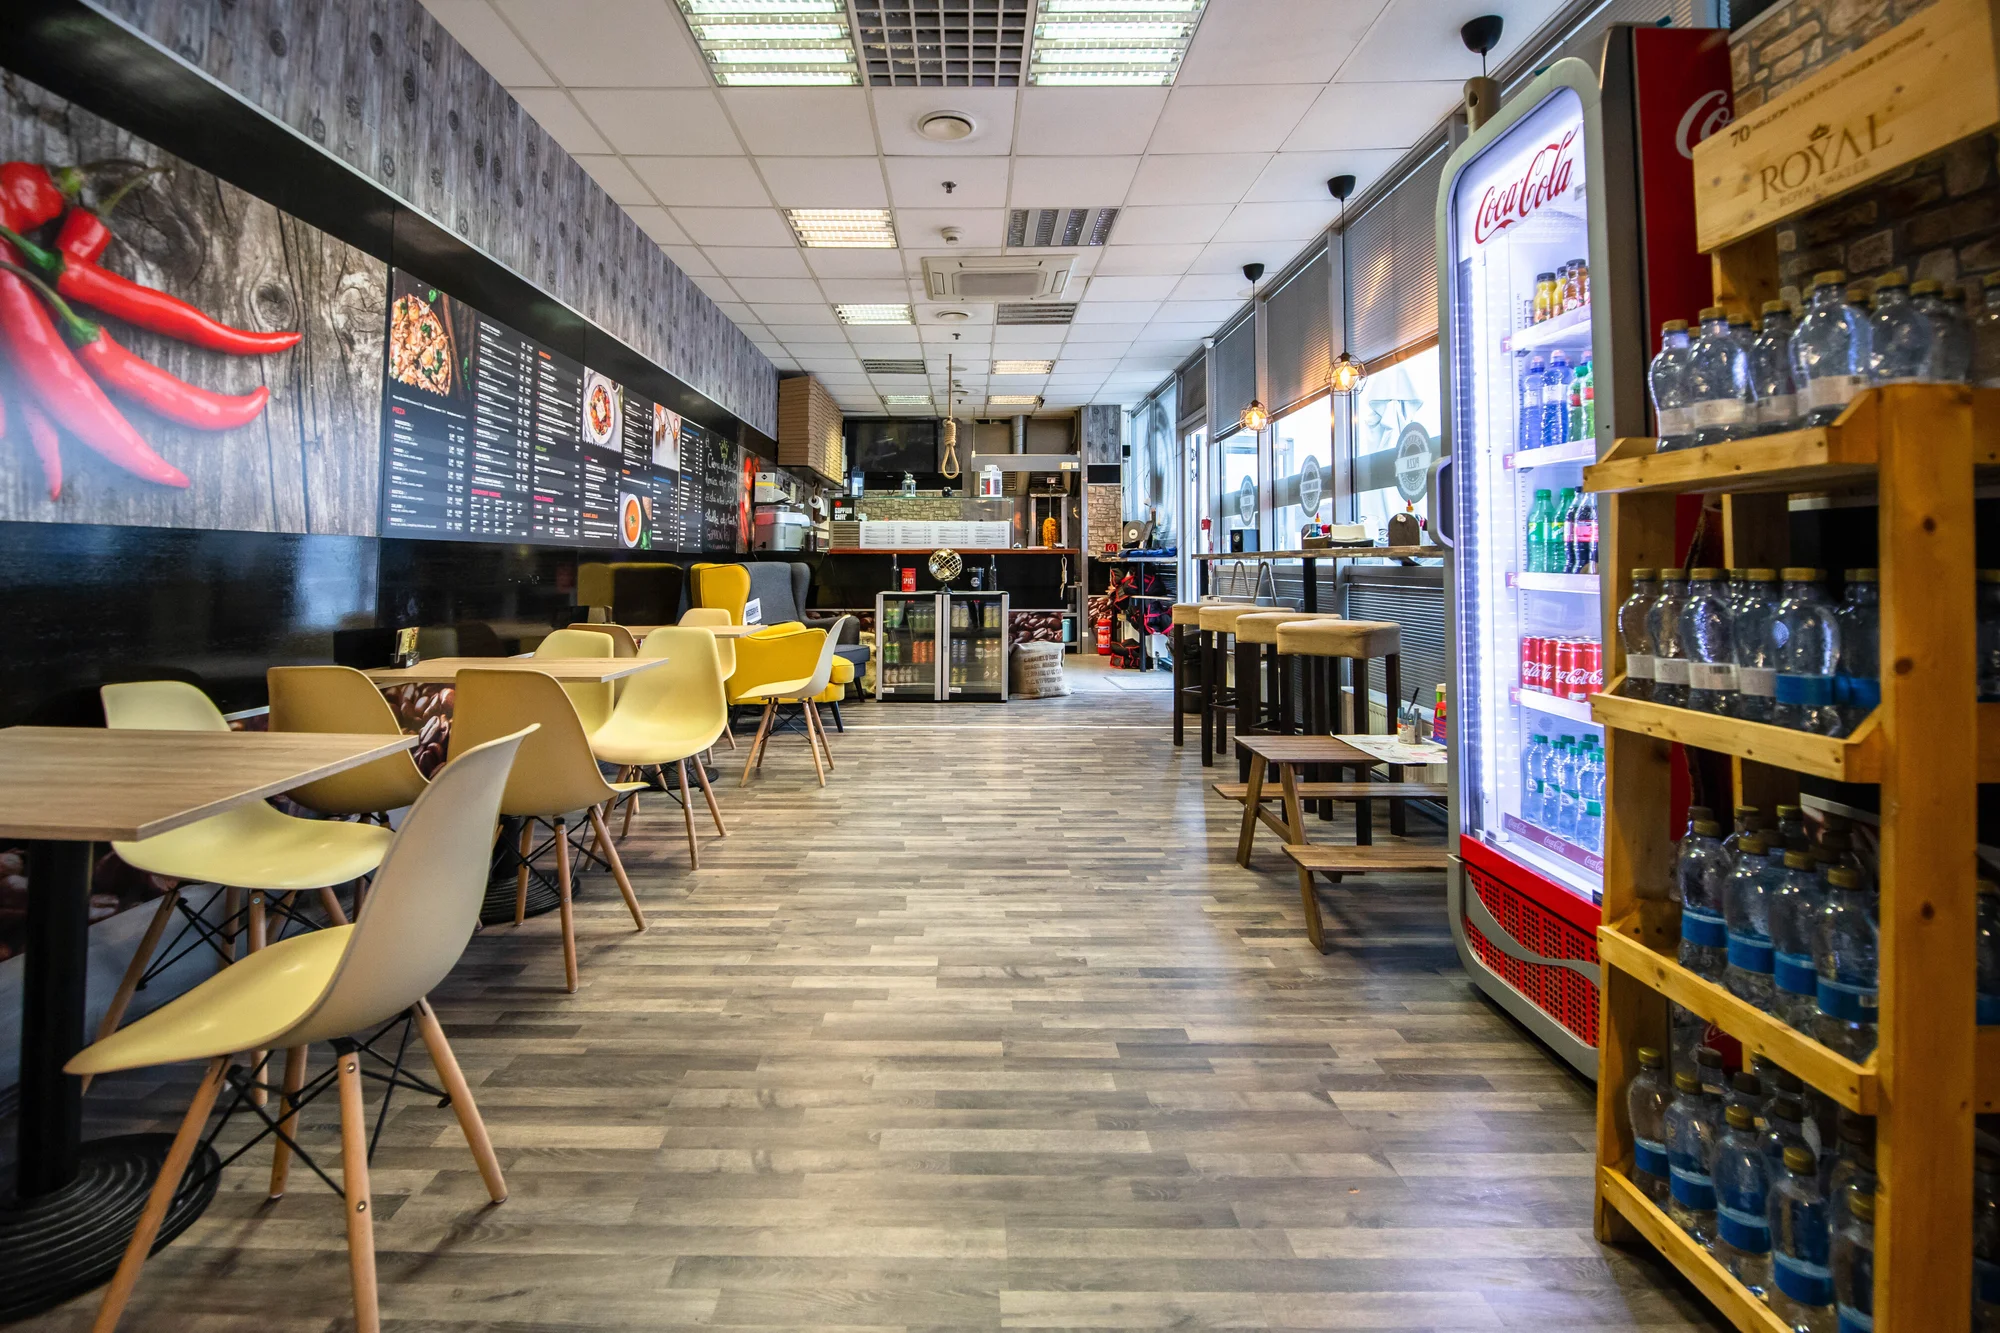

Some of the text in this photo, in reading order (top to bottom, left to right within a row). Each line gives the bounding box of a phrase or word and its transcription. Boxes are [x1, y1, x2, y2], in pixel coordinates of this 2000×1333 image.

[1730, 124, 1751, 148] 70
[1760, 114, 1895, 202] ROYAL
[1475, 123, 1580, 244] Coca-Cola
